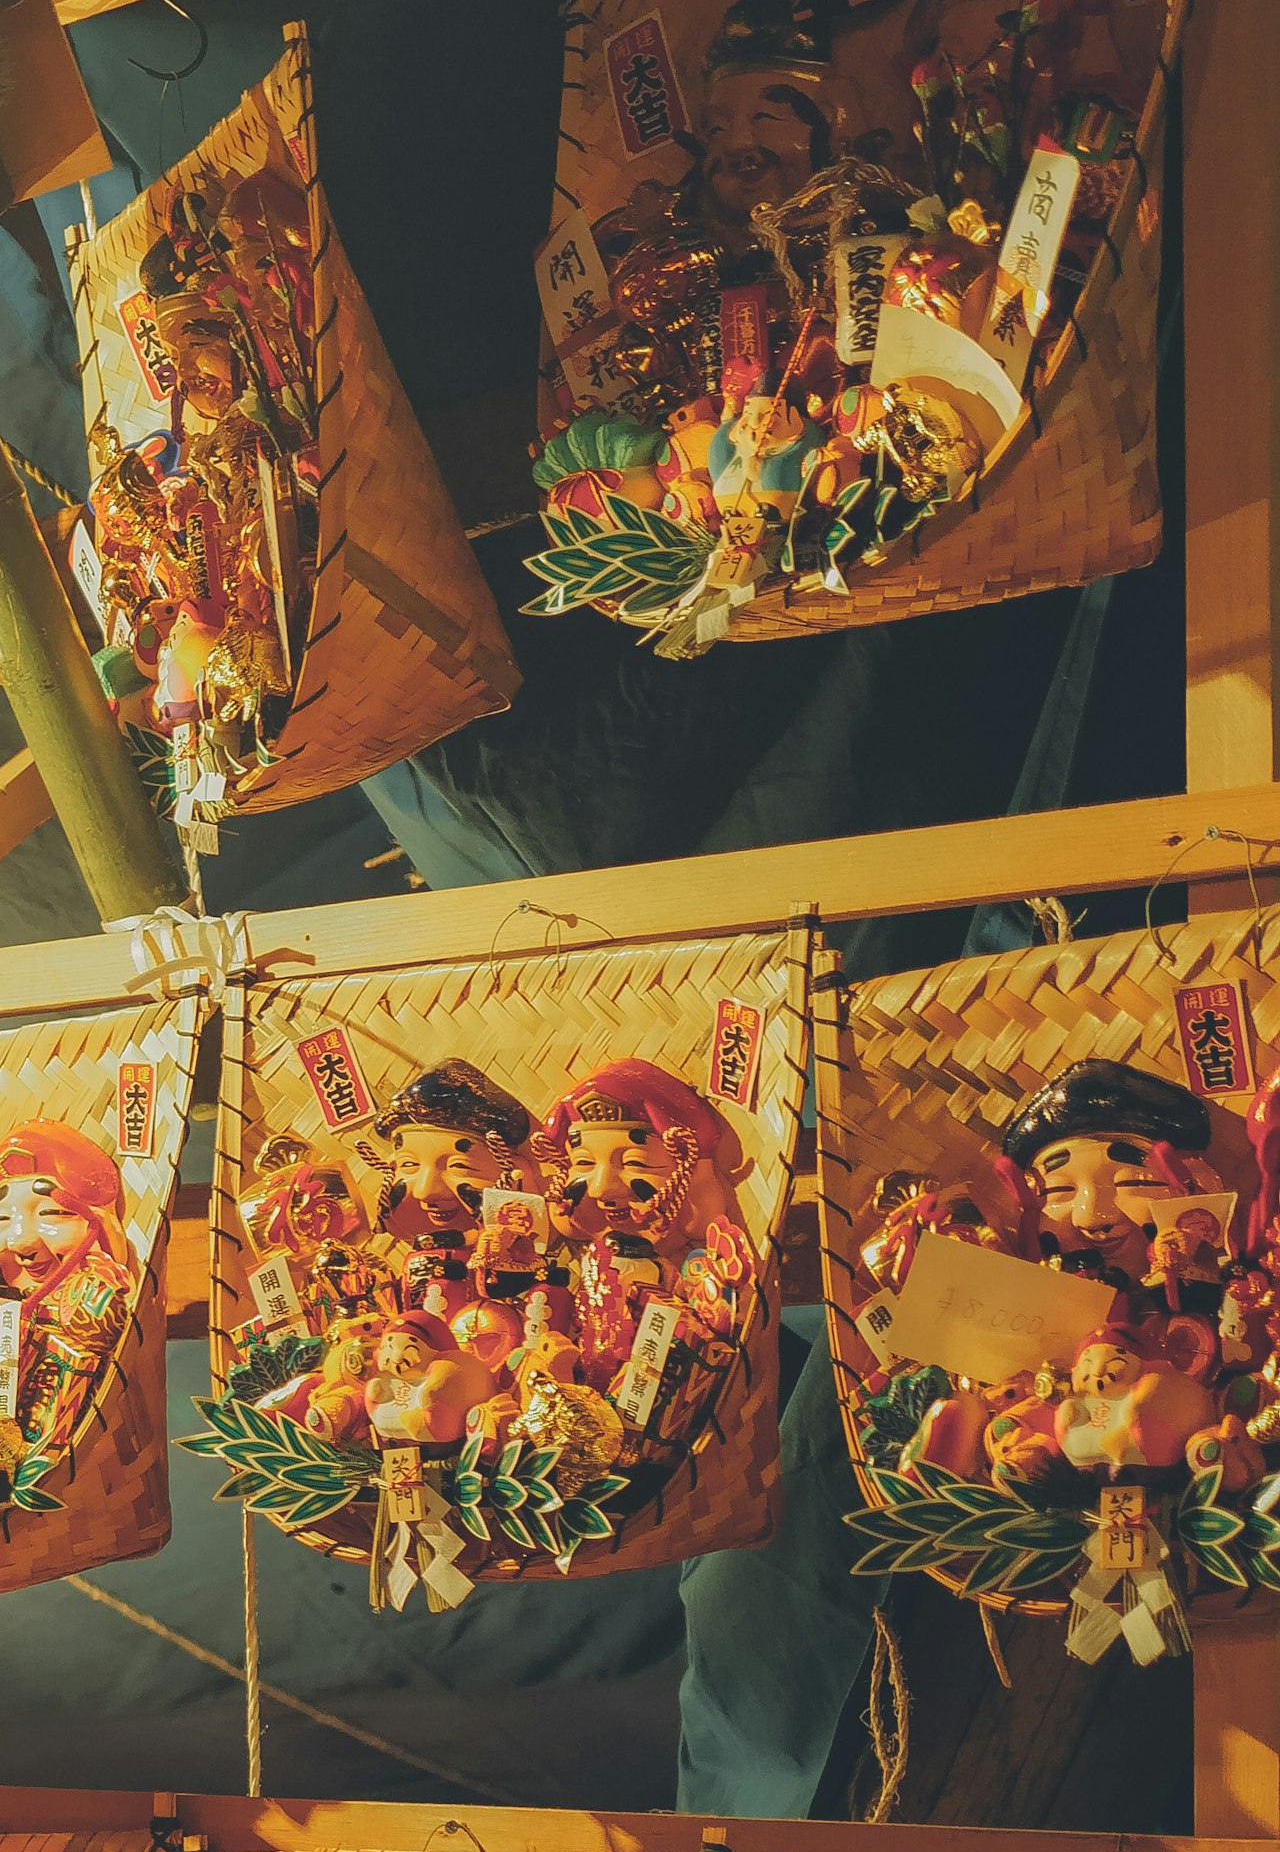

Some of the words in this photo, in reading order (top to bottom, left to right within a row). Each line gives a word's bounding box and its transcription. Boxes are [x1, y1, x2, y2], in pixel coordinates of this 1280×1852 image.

[622, 51, 674, 146] 大吉
[847, 244, 887, 354] 家内安全
[134, 318, 177, 394] 大吉
[719, 1004, 758, 1031] 開運
[1182, 988, 1230, 1010] 開運
[302, 1029, 342, 1058] 開運
[717, 1023, 750, 1097] 大吉
[1187, 1009, 1236, 1089] 大吉
[124, 1082, 150, 1150] 大吉
[316, 1051, 359, 1122] 大吉
